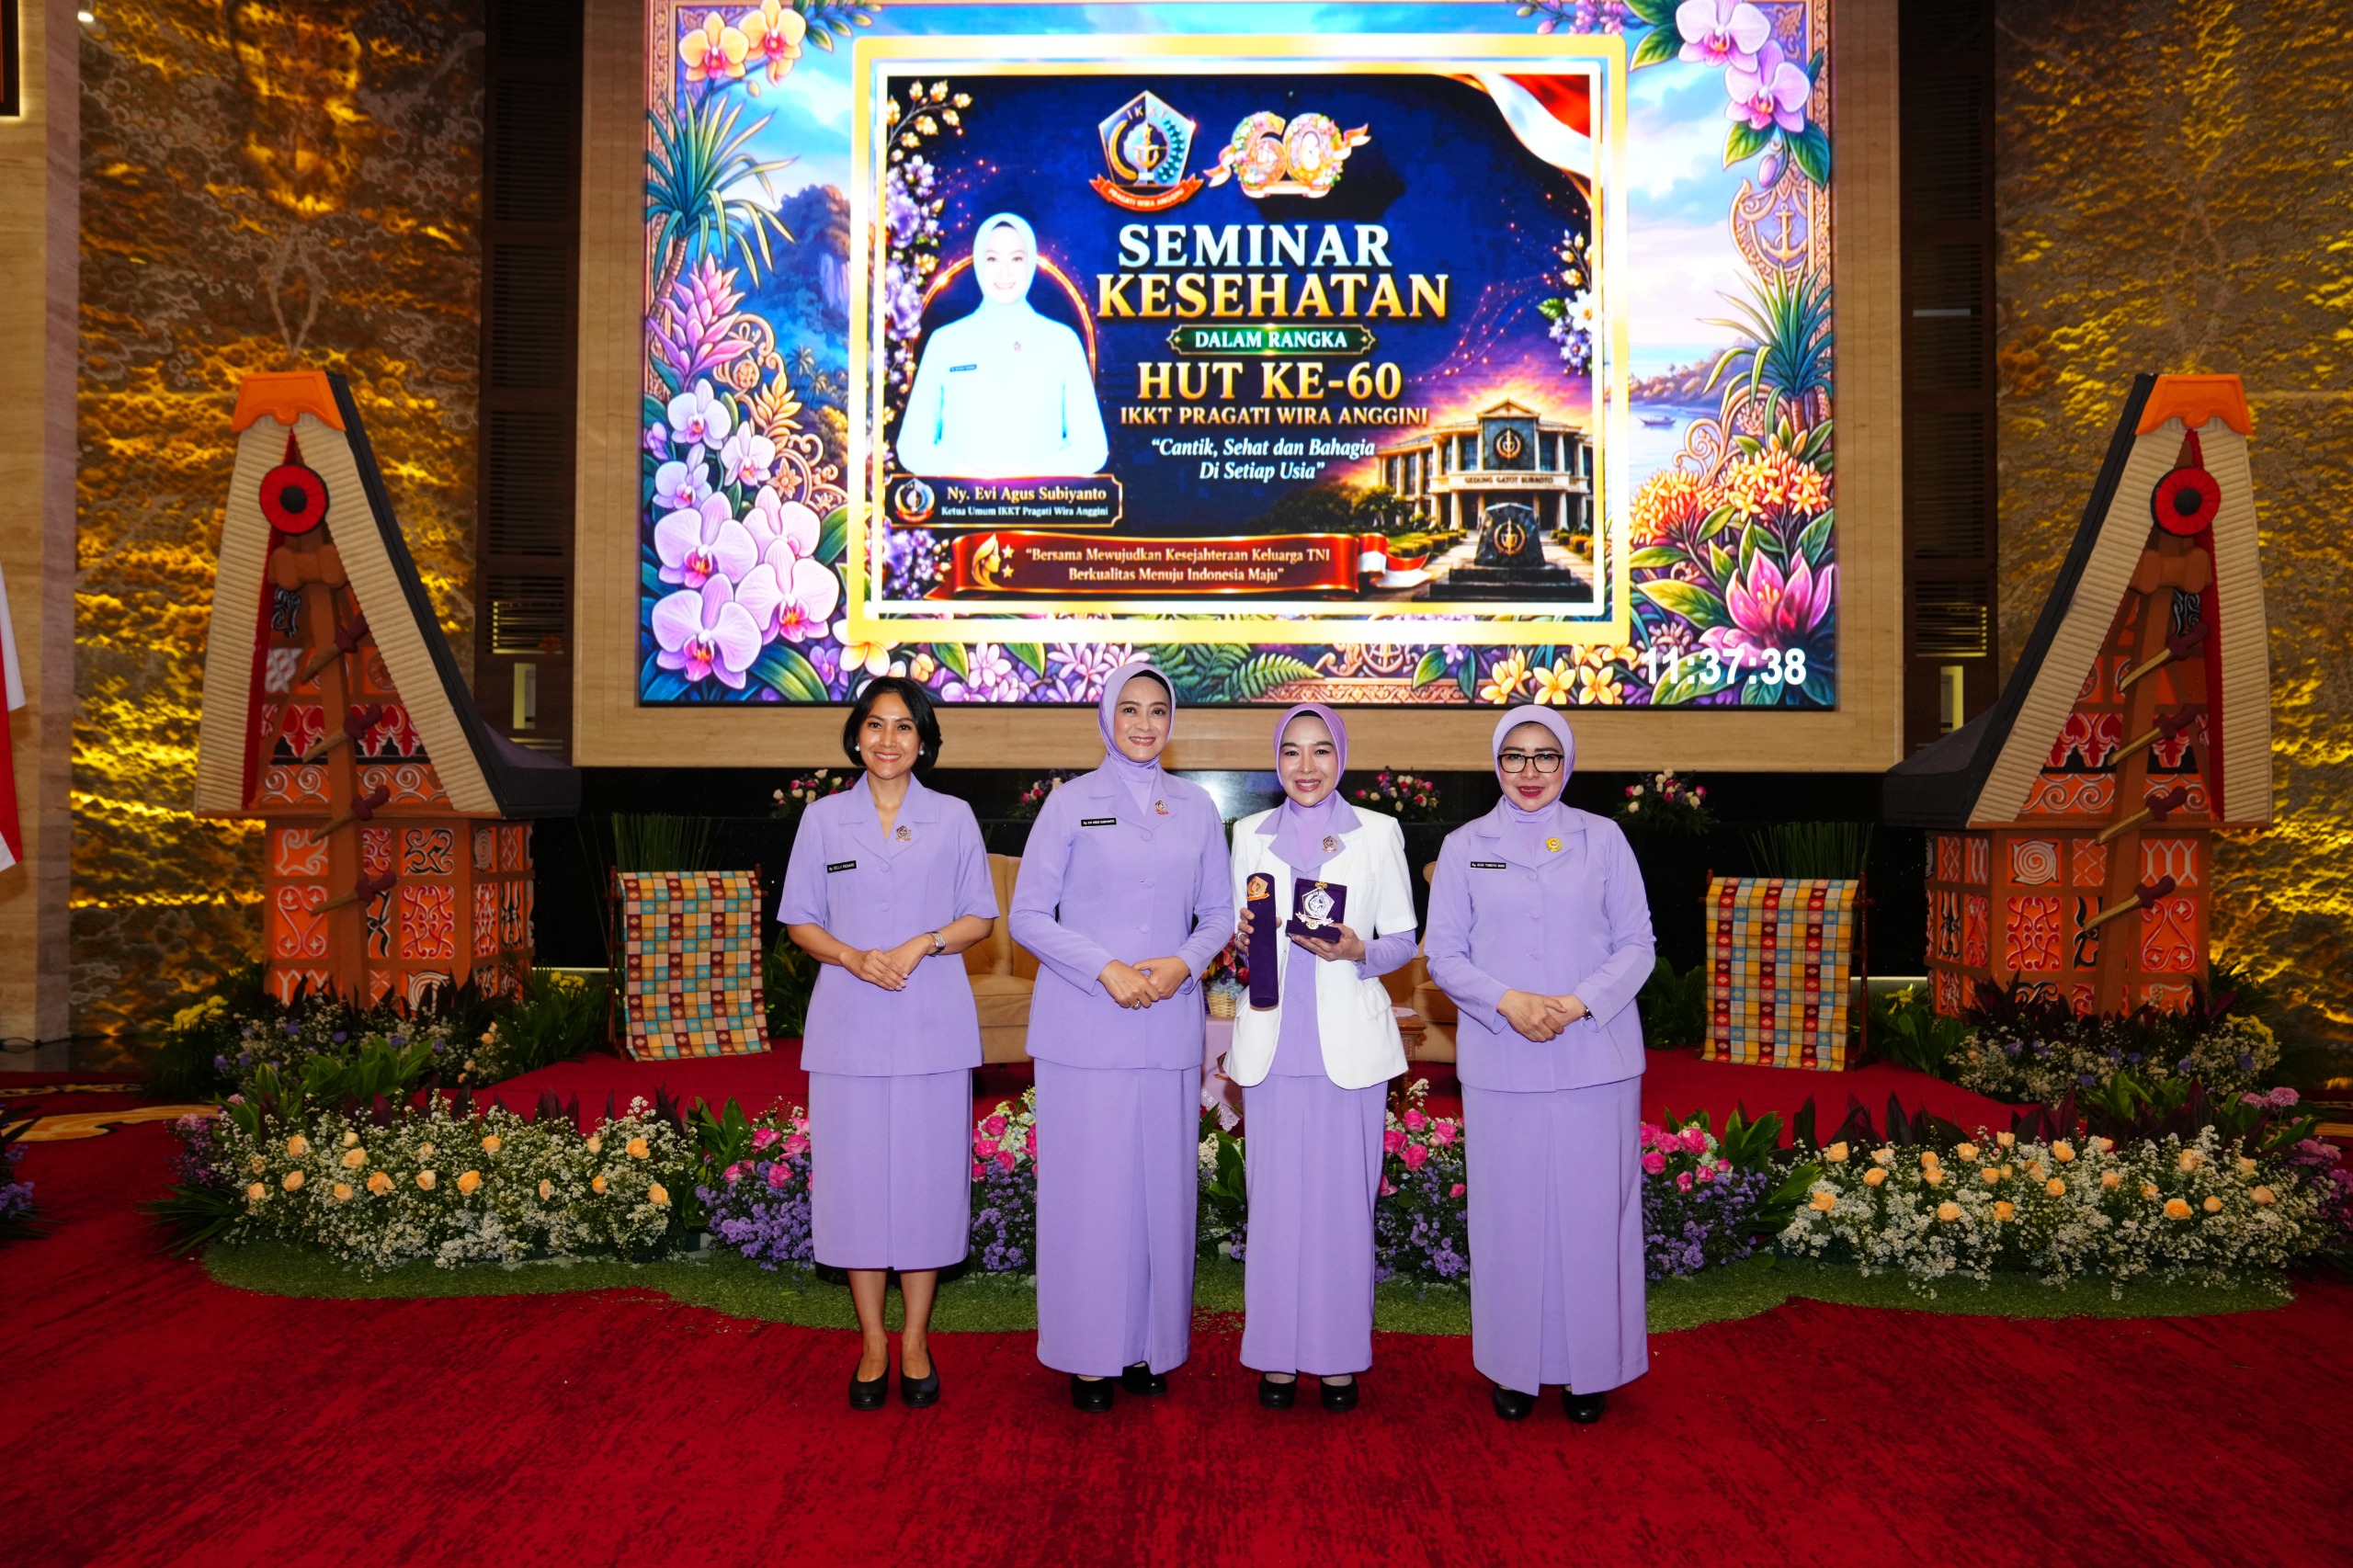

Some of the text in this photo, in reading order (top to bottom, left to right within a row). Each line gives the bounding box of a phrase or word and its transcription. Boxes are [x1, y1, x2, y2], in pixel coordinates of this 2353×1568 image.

[1118, 224, 1393, 268] SEMINAR
[1097, 273, 1449, 318] KESEHATAN
[1196, 331, 1348, 349] DALAM RANGKA
[1137, 361, 1403, 400] HUT KE-60
[1120, 407, 1429, 426] IKKT PRAGATI WIRA ANGGINI
[1151, 437, 1376, 460] “Cantik, Sehat dan Bahagia
[1199, 461, 1325, 483] Di Setiap Usia”
[947, 485, 1108, 505] Ny. Evi Agus Subiyanto
[941, 506, 966, 517] Ketua
[968, 506, 996, 517] Umum
[998, 506, 1021, 517] IKKT
[1022, 506, 1052, 518] Pragati
[1053, 506, 1074, 517] Wira
[1075, 506, 1108, 518] Anggini
[1025, 547, 1330, 565] “Bersama Mewujudkan Kesejahteraan Keluarga TNI
[1068, 567, 1285, 585] Berkualitas Menuju Indonesia Maju”
[1641, 647, 1807, 686] 11:37:38
